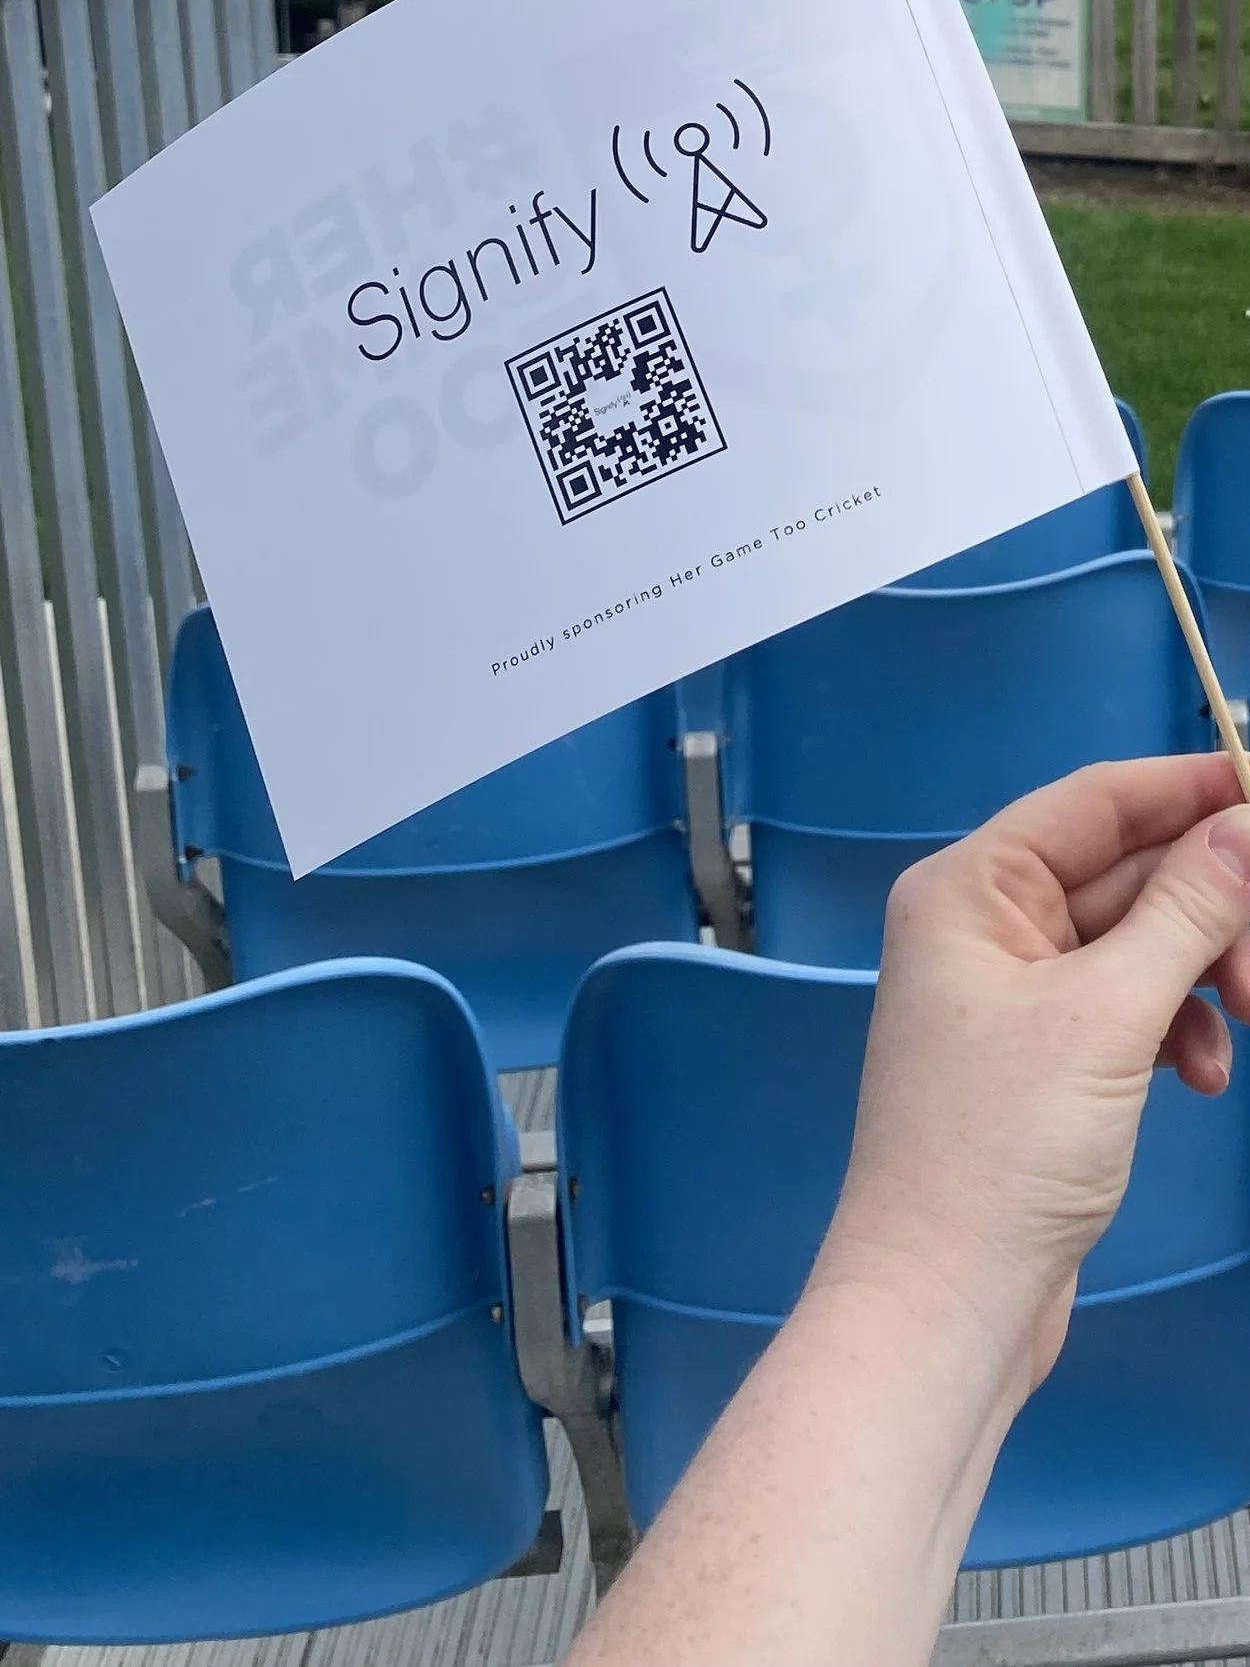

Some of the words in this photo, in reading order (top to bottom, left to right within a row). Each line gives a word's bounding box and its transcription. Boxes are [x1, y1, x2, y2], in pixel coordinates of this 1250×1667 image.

[348, 189, 597, 361] Signify
[491, 635, 555, 676] Proudly
[562, 584, 663, 640] sponsoring
[669, 565, 701, 588] Her
[710, 538, 763, 568] Game
[769, 519, 806, 542] Too
[814, 485, 882, 522] Cricket
